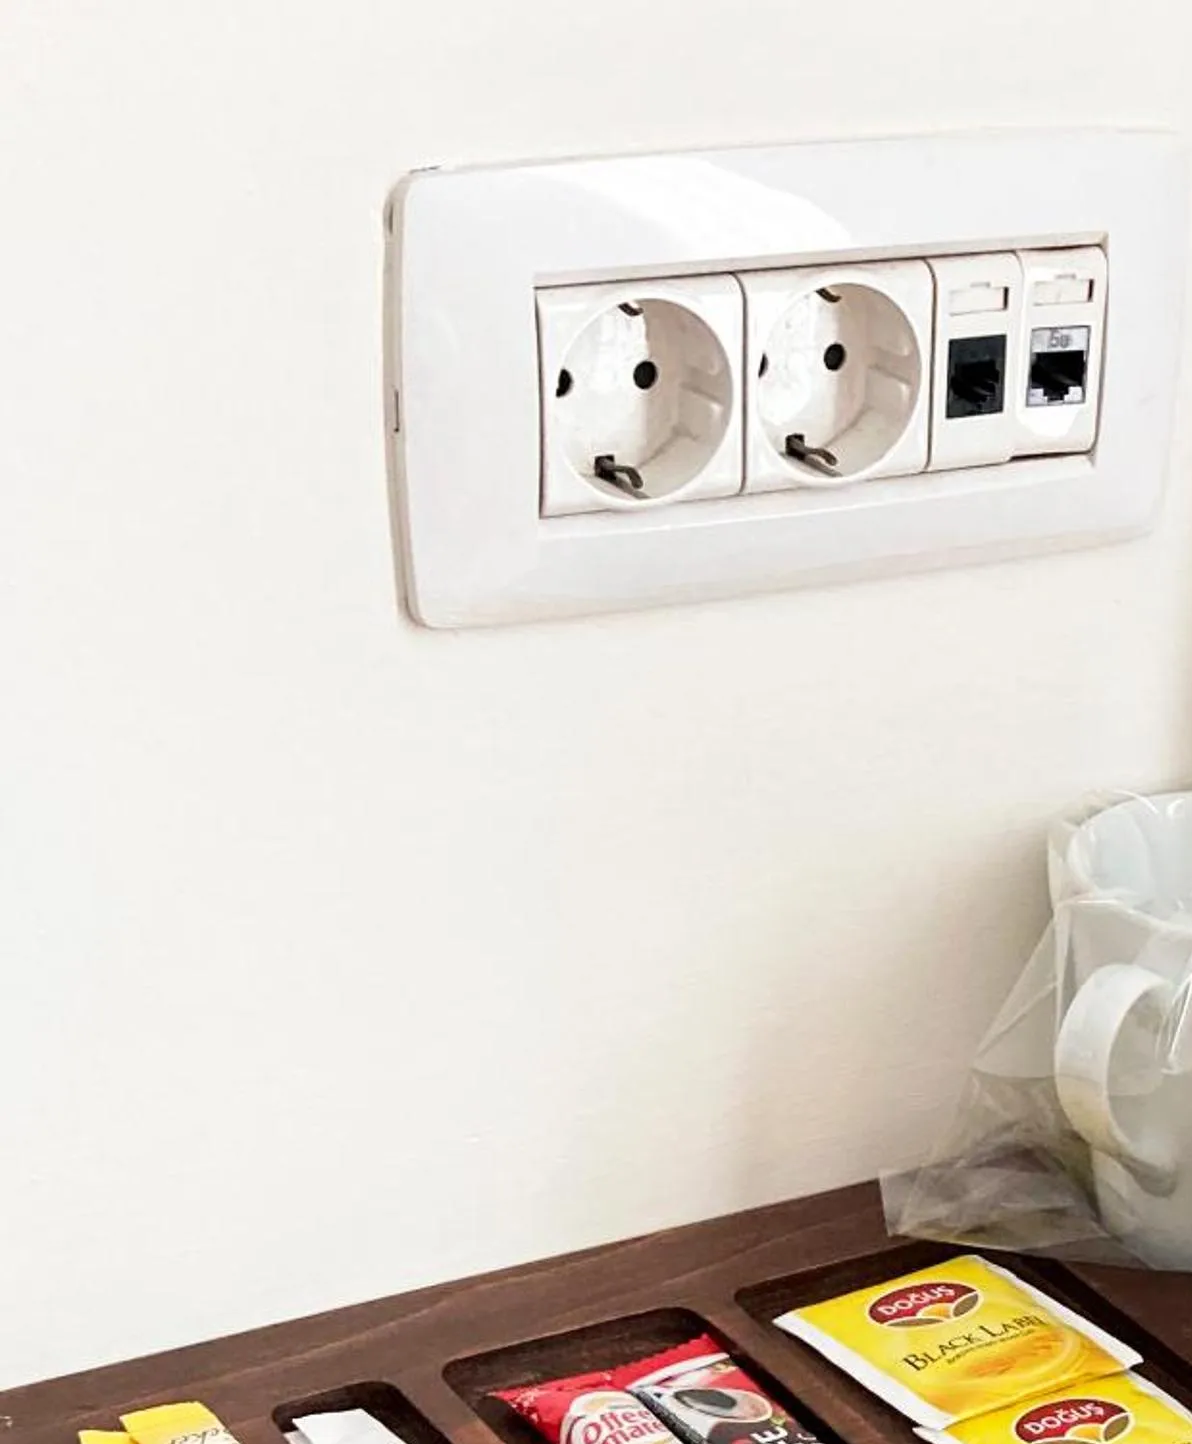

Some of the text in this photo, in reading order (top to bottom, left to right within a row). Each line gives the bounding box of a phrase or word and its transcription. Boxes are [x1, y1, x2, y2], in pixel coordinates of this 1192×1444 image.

[903, 1332, 980, 1371] BLACK
[979, 1314, 1049, 1337] LABEL
[1024, 1403, 1105, 1435] DOĞUŞ
